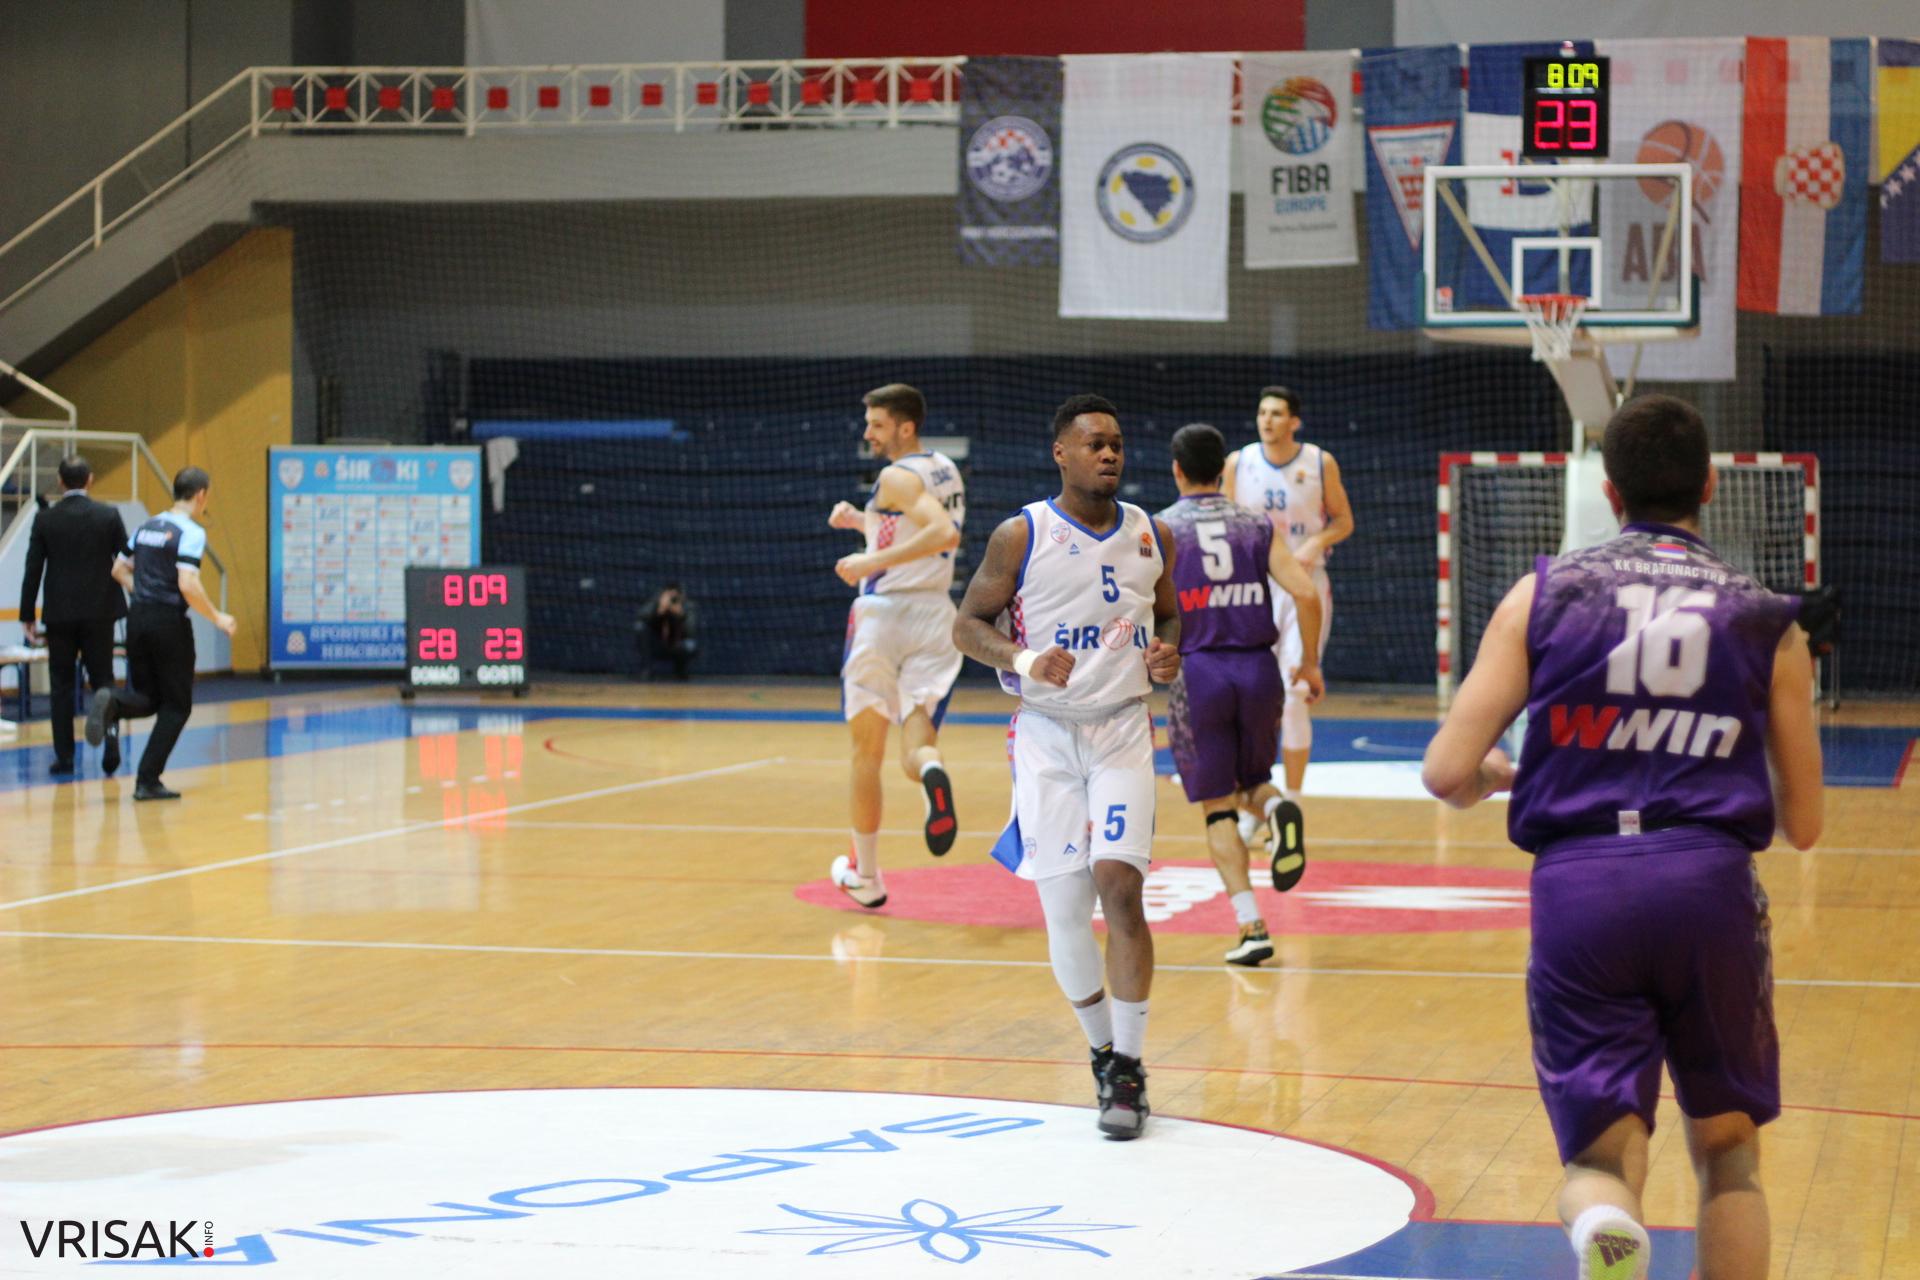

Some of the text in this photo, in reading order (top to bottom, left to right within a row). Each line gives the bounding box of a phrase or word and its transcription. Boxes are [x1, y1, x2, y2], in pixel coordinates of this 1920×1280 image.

[1534, 99, 1598, 149] 23
[1270, 163, 1331, 195] FIBA
[1274, 197, 1327, 216] EUROPE
[1263, 488, 1287, 511] 33
[1194, 520, 1234, 581] 5
[1101, 565, 1120, 603] 5
[1614, 559, 1631, 572] KK
[1635, 561, 1700, 578] BRATUNAC
[418, 628, 457, 660] 28
[484, 627, 523, 660] 23
[1605, 583, 1717, 698] 16
[477, 664, 524, 685] GOSTI
[1103, 804, 1127, 842] 5
